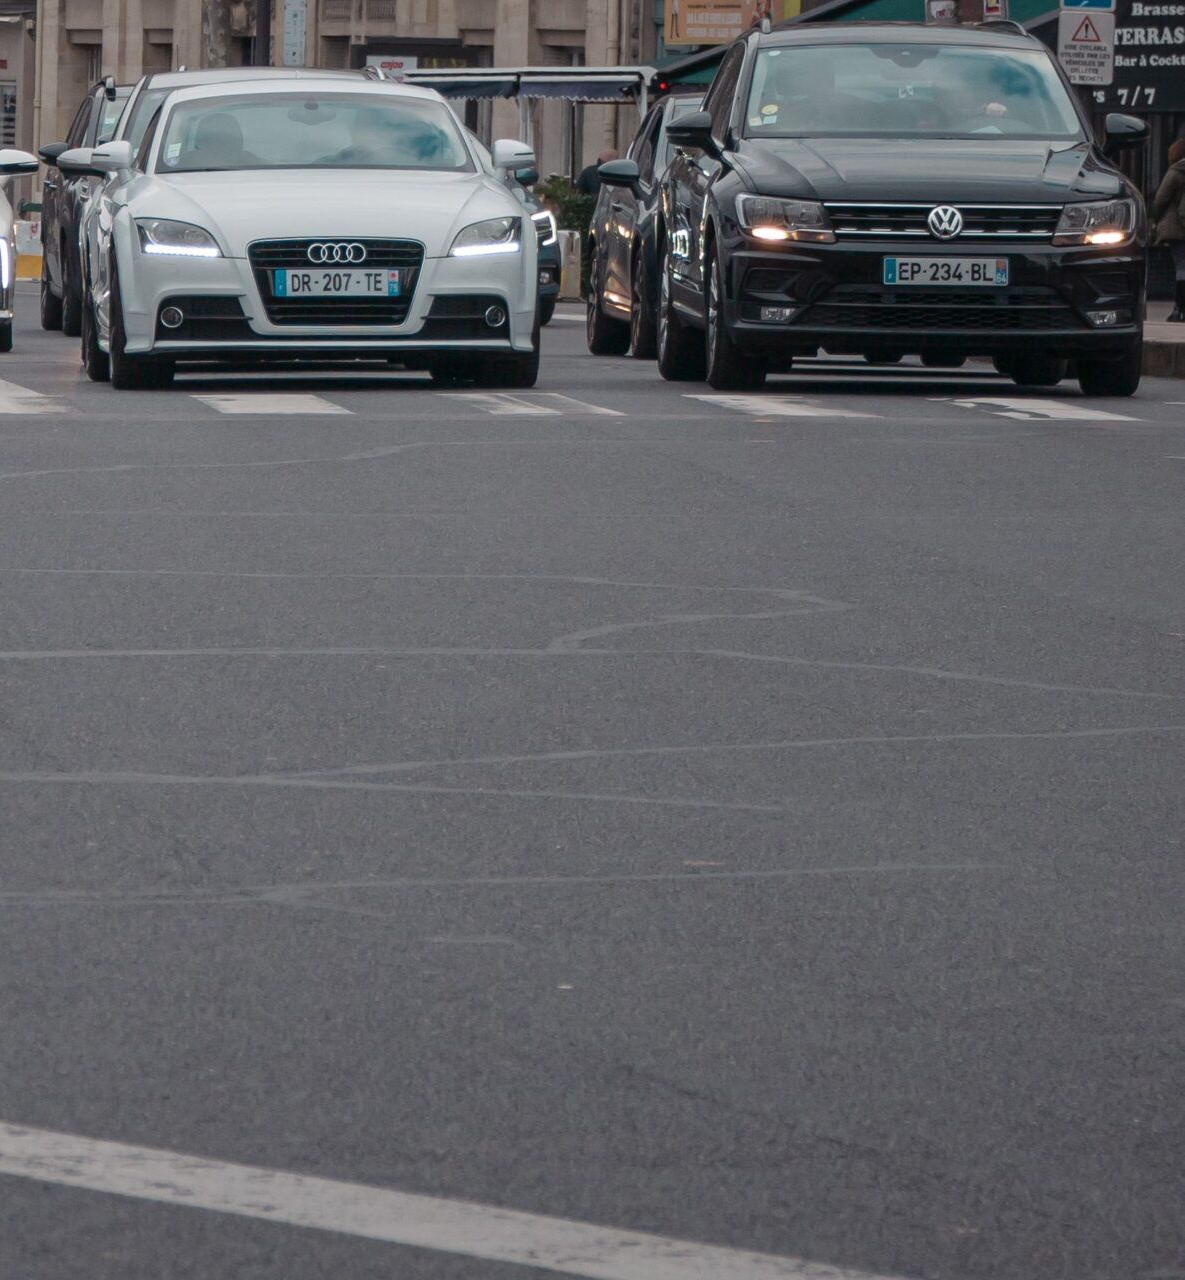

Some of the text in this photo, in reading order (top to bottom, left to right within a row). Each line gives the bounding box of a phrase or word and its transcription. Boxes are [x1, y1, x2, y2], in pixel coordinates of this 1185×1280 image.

[1131, 2, 1185, 16] Brasse
[1114, 54, 1137, 67] Bar
[1139, 54, 1147, 67] à
[899, 262, 993, 281] EP-234-BL
[291, 273, 382, 292] DR-207-TE
